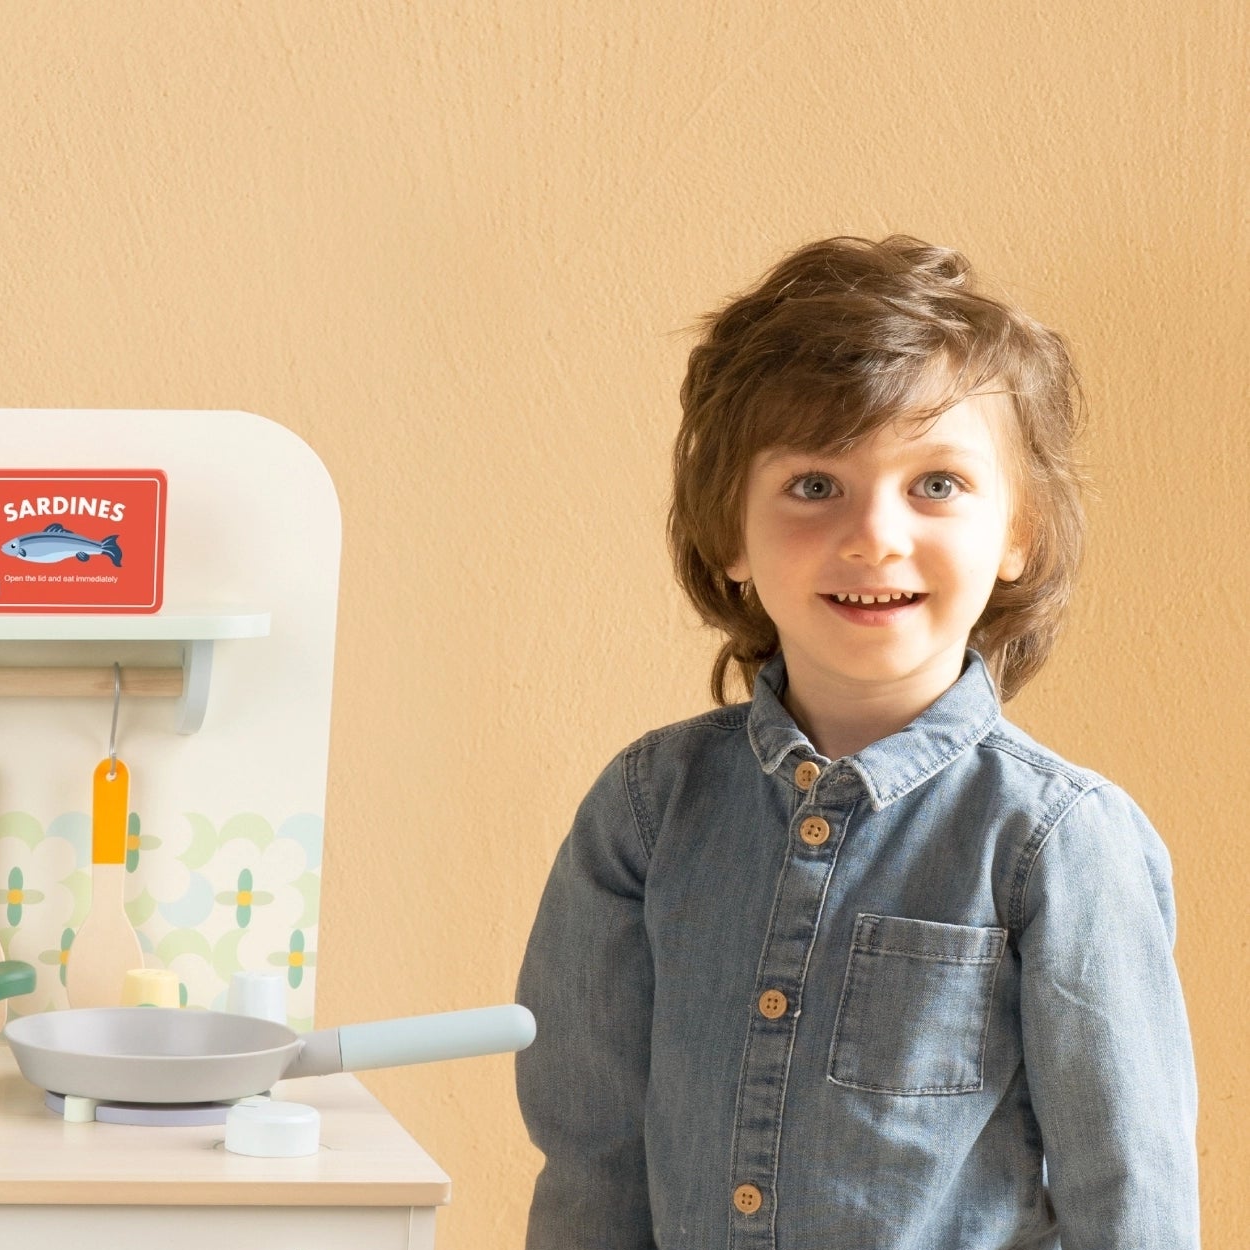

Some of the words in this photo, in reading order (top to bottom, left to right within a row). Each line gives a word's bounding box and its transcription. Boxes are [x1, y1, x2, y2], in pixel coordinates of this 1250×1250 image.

[3, 496, 126, 522] SARDINES
[4, 574, 24, 583] Open
[63, 575, 75, 583] eat
[76, 575, 119, 584] immediately
